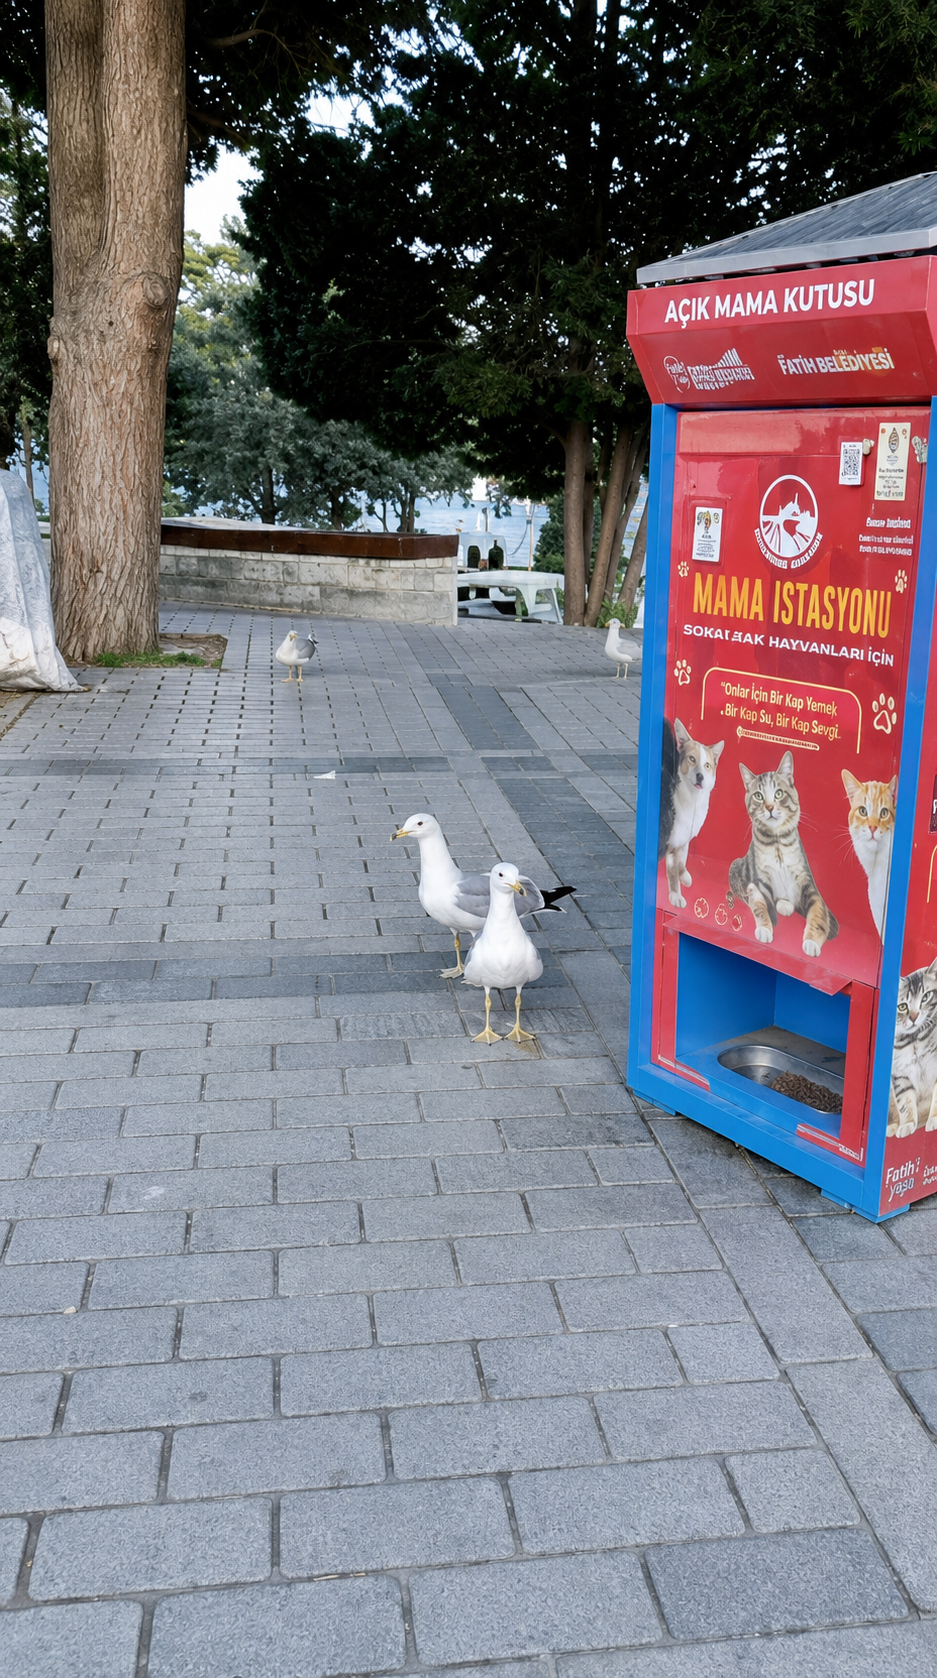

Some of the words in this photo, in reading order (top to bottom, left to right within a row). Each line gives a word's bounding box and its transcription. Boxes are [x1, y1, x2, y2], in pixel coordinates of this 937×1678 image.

[664, 296, 710, 328] AÇIK
[714, 289, 778, 319] MAMA
[783, 278, 875, 313] KUTUSU
[777, 354, 818, 375] FATİH
[815, 347, 895, 374] BELEDİYESİ
[693, 572, 764, 621] MAMA
[773, 580, 892, 638] ISTASYONU
[768, 636, 864, 660] HAYVANLARI
[867, 646, 894, 667] İÇİN
[751, 682, 768, 705] İçin
[769, 690, 783, 706] Bir
[785, 693, 804, 712] Kap
[806, 696, 838, 717] Yemek
[740, 706, 758, 724] Kap
[759, 709, 774, 728] Su,
[776, 712, 790, 728] Bir
[791, 716, 810, 735] Kap
